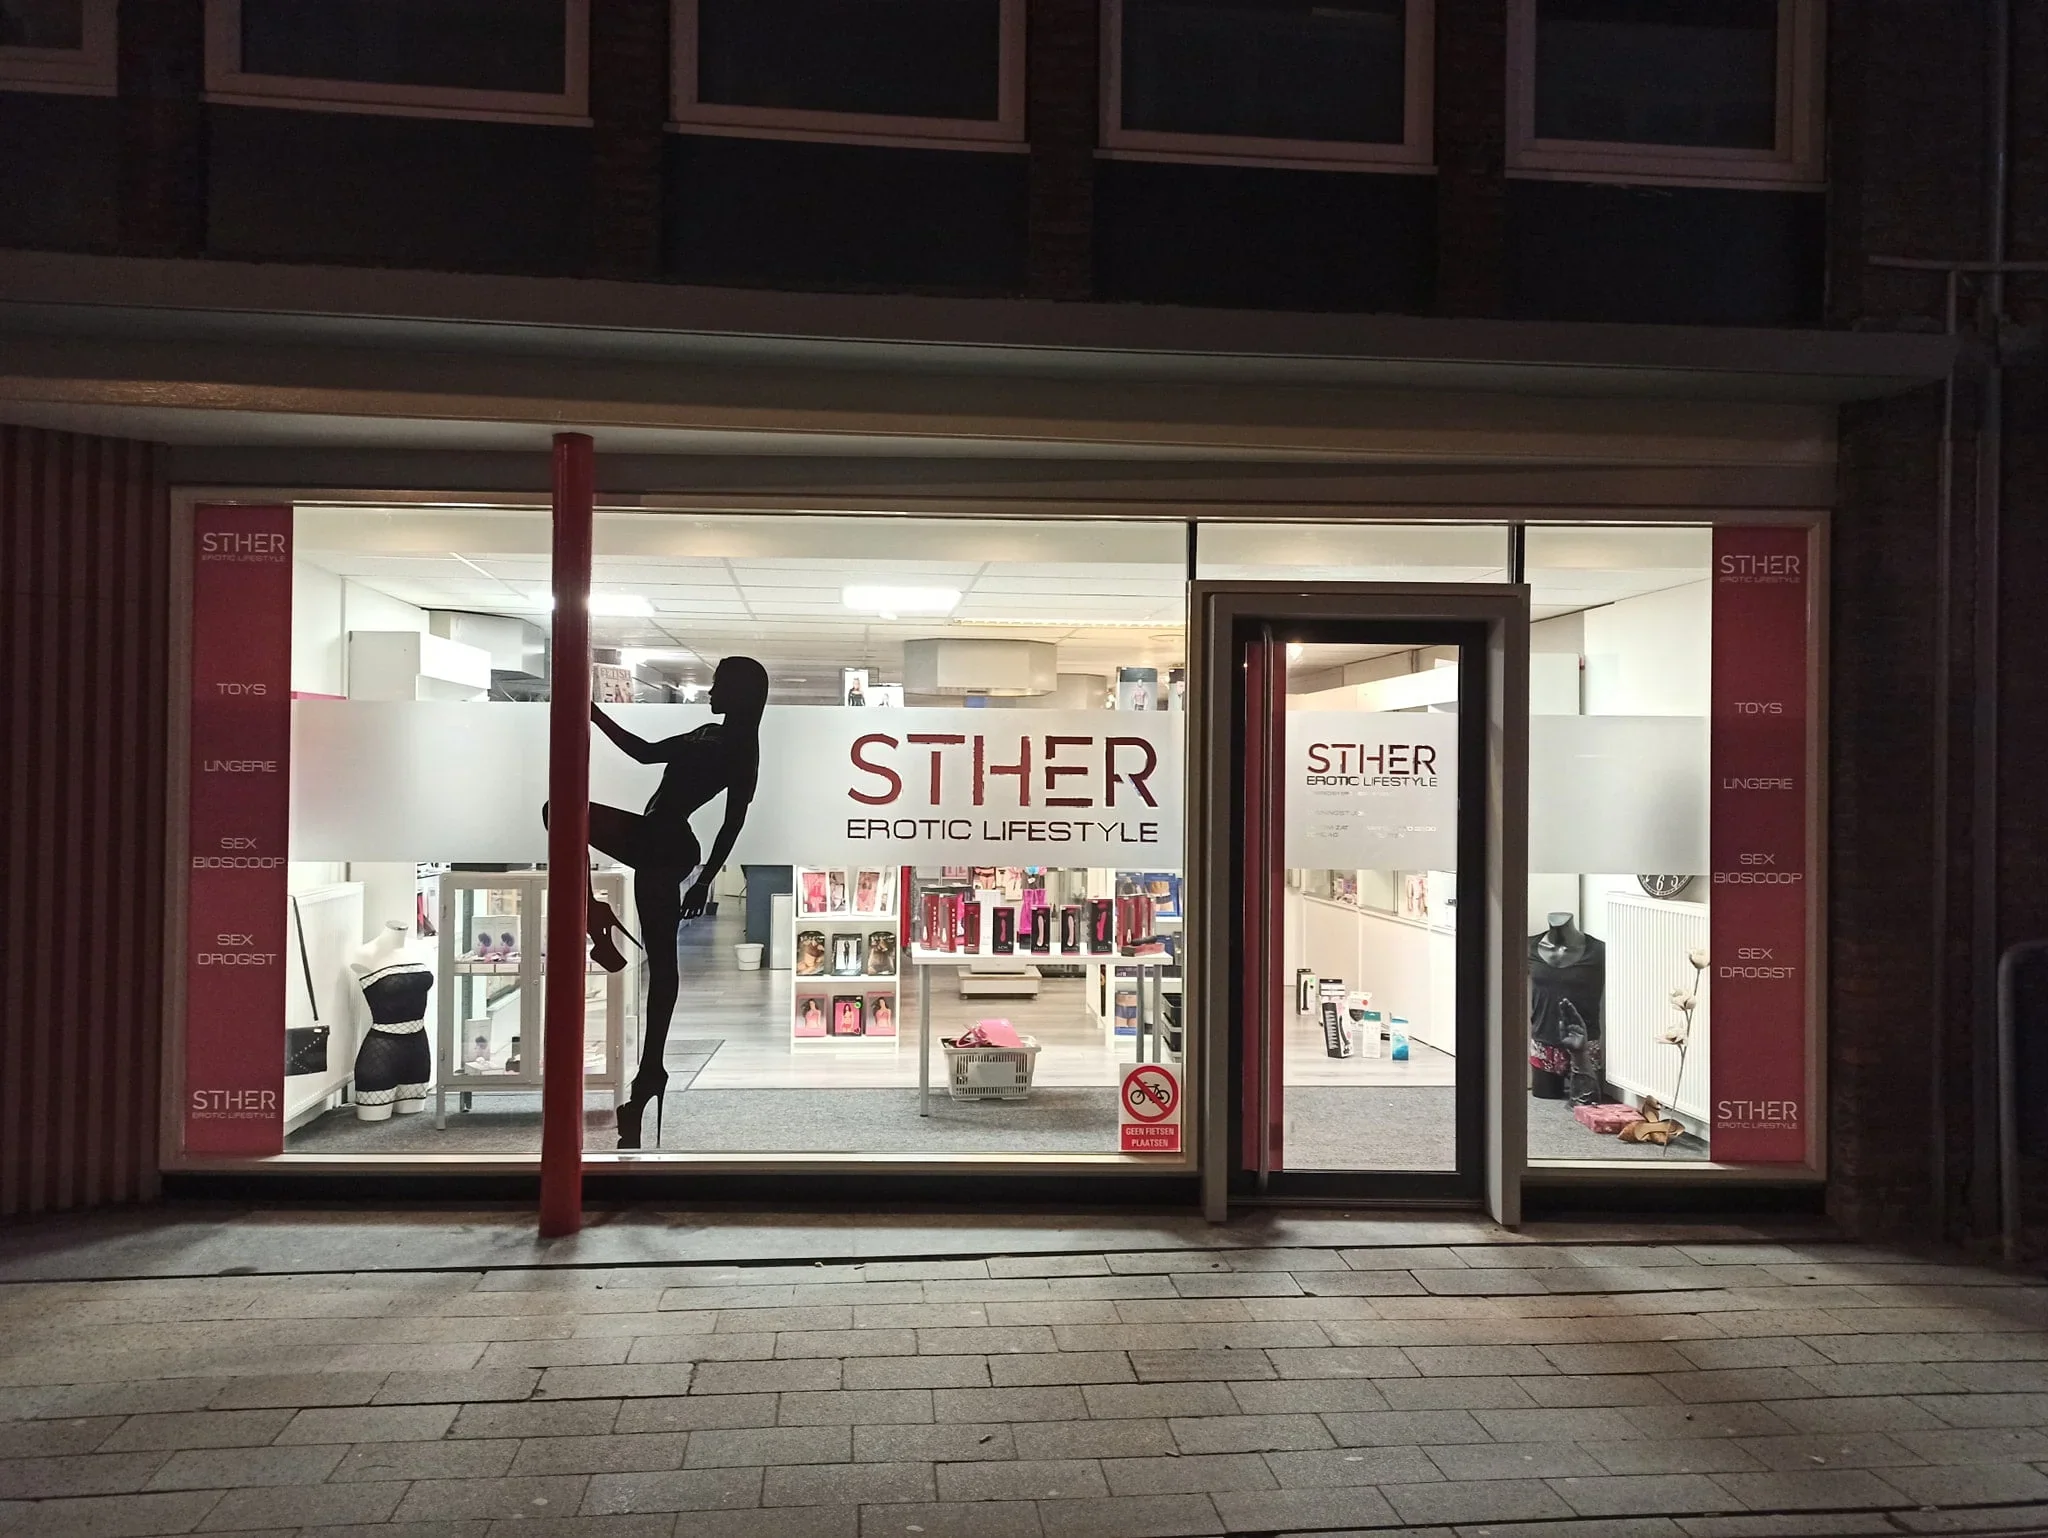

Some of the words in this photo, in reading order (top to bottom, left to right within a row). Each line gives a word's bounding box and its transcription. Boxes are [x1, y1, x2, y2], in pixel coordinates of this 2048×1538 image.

[202, 532, 286, 553] STHER
[1720, 554, 1800, 575] STHER
[216, 683, 267, 695] TOYS
[1734, 702, 1783, 714] TOYS
[1307, 743, 1437, 775] STHER
[204, 760, 277, 773] LINGERIE
[847, 733, 1159, 808] STHER
[1306, 775, 1359, 786] EROTIC
[1363, 776, 1438, 787] LIFESTYLE
[1723, 778, 1793, 790] LINGERIE
[847, 818, 972, 840] EROTIC
[983, 820, 1159, 843] LIFESTYLE
[220, 837, 257, 849] SEX
[192, 856, 285, 869] BIOSCOOP
[1740, 853, 1775, 865] SEX
[1713, 872, 1803, 884] BIOSCOOP
[217, 934, 254, 946] SEX
[197, 953, 277, 966] DROGIST
[1738, 948, 1773, 960] SEX
[1720, 966, 1796, 979] DROGIST
[192, 1089, 276, 1110] STHER
[1717, 1100, 1798, 1121] STHER
[1125, 1127, 1144, 1136] GEEN
[1145, 1127, 1175, 1136] FIETSEN
[1752, 1122, 1798, 1130] LIFESTYLE
[1131, 1139, 1169, 1148] PLAATSEN
